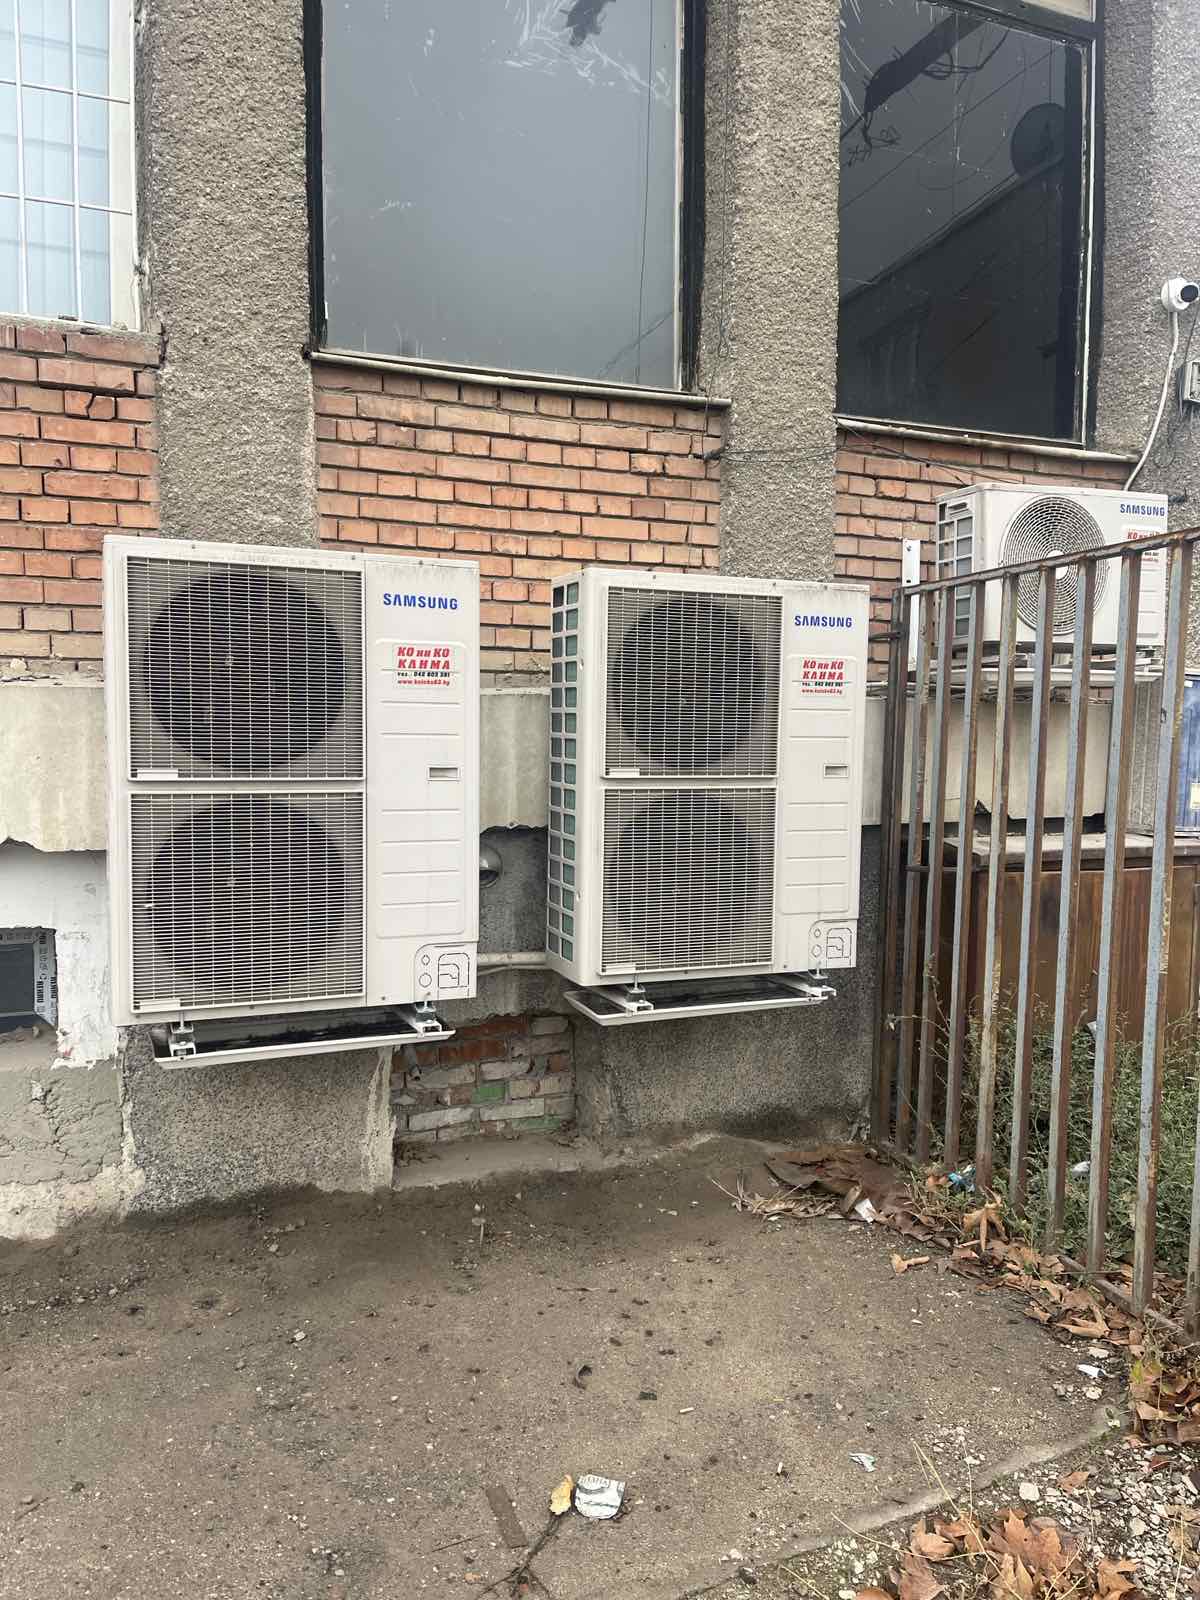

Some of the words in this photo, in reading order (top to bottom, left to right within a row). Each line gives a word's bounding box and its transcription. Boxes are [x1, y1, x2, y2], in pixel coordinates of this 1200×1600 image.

[1120, 504, 1165, 516] SAMSUNG
[383, 593, 458, 610] SAMSUNG
[794, 615, 852, 628] SAMSUNG
